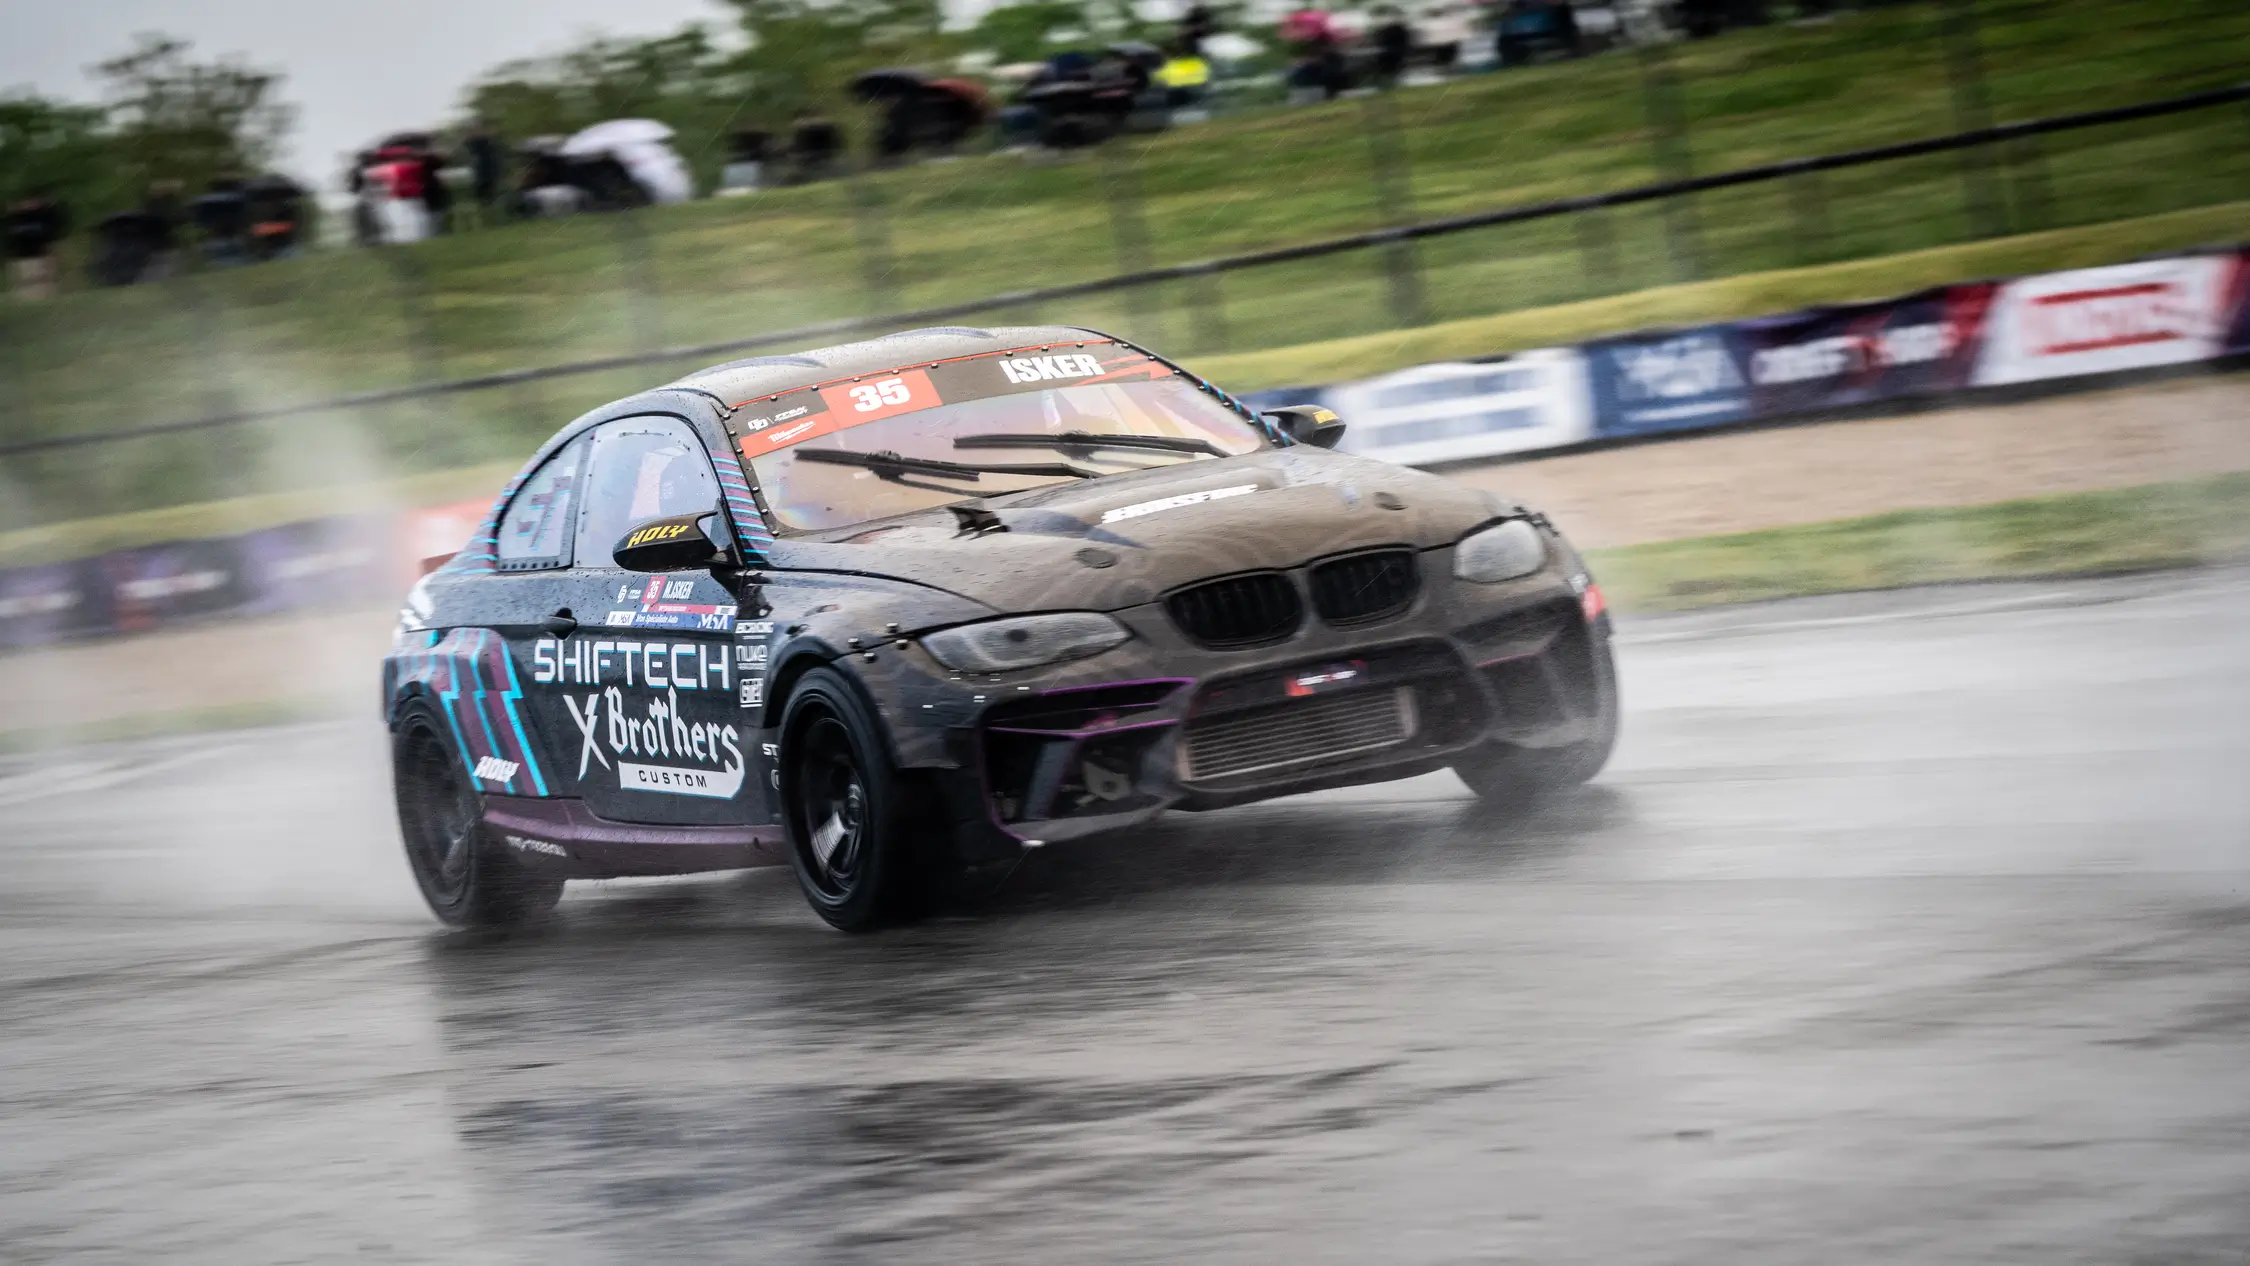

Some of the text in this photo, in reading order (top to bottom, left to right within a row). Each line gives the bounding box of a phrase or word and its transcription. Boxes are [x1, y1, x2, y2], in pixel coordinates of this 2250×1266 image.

[999, 354, 1105, 384] ISKER
[849, 378, 911, 412] 35
[627, 524, 688, 548] HOLY
[646, 581, 661, 599] 35
[534, 639, 730, 691] SHIFTECH
[562, 685, 745, 781] X Brothers
[638, 769, 707, 788] CUSTOM
